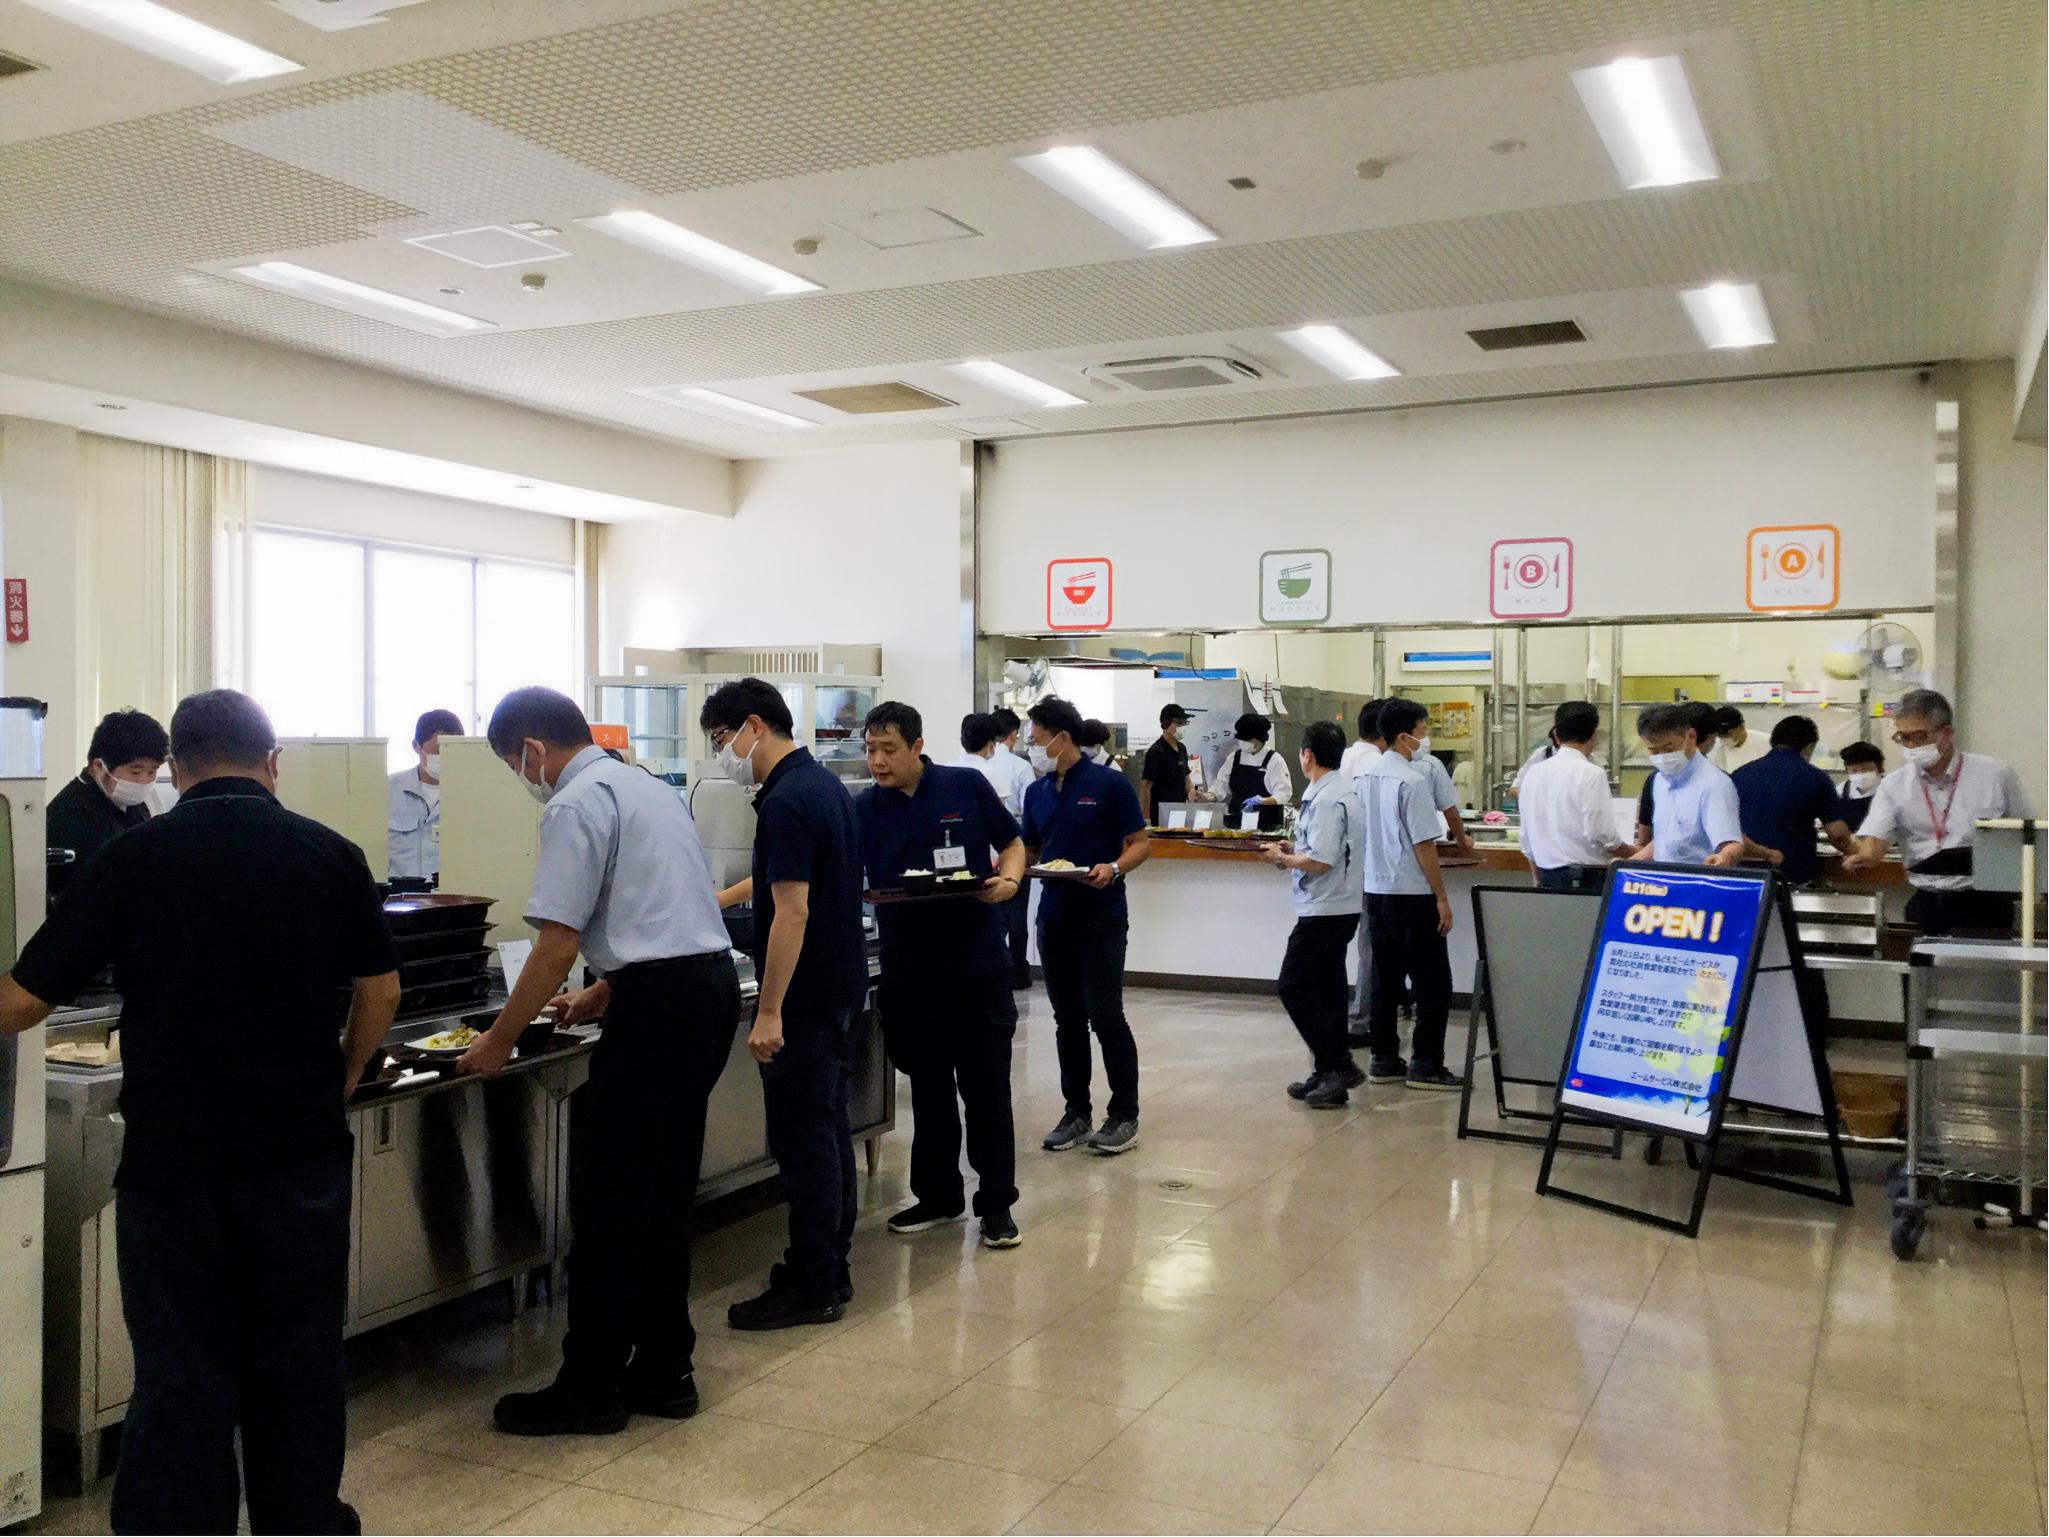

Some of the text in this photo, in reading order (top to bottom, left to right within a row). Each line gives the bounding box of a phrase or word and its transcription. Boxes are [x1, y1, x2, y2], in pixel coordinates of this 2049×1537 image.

[1786, 553, 1800, 568] A
[1526, 565, 1537, 578] B
[9, 581, 24, 623] 消火器
[1630, 1071, 1702, 1092] エームサービス株式会社
